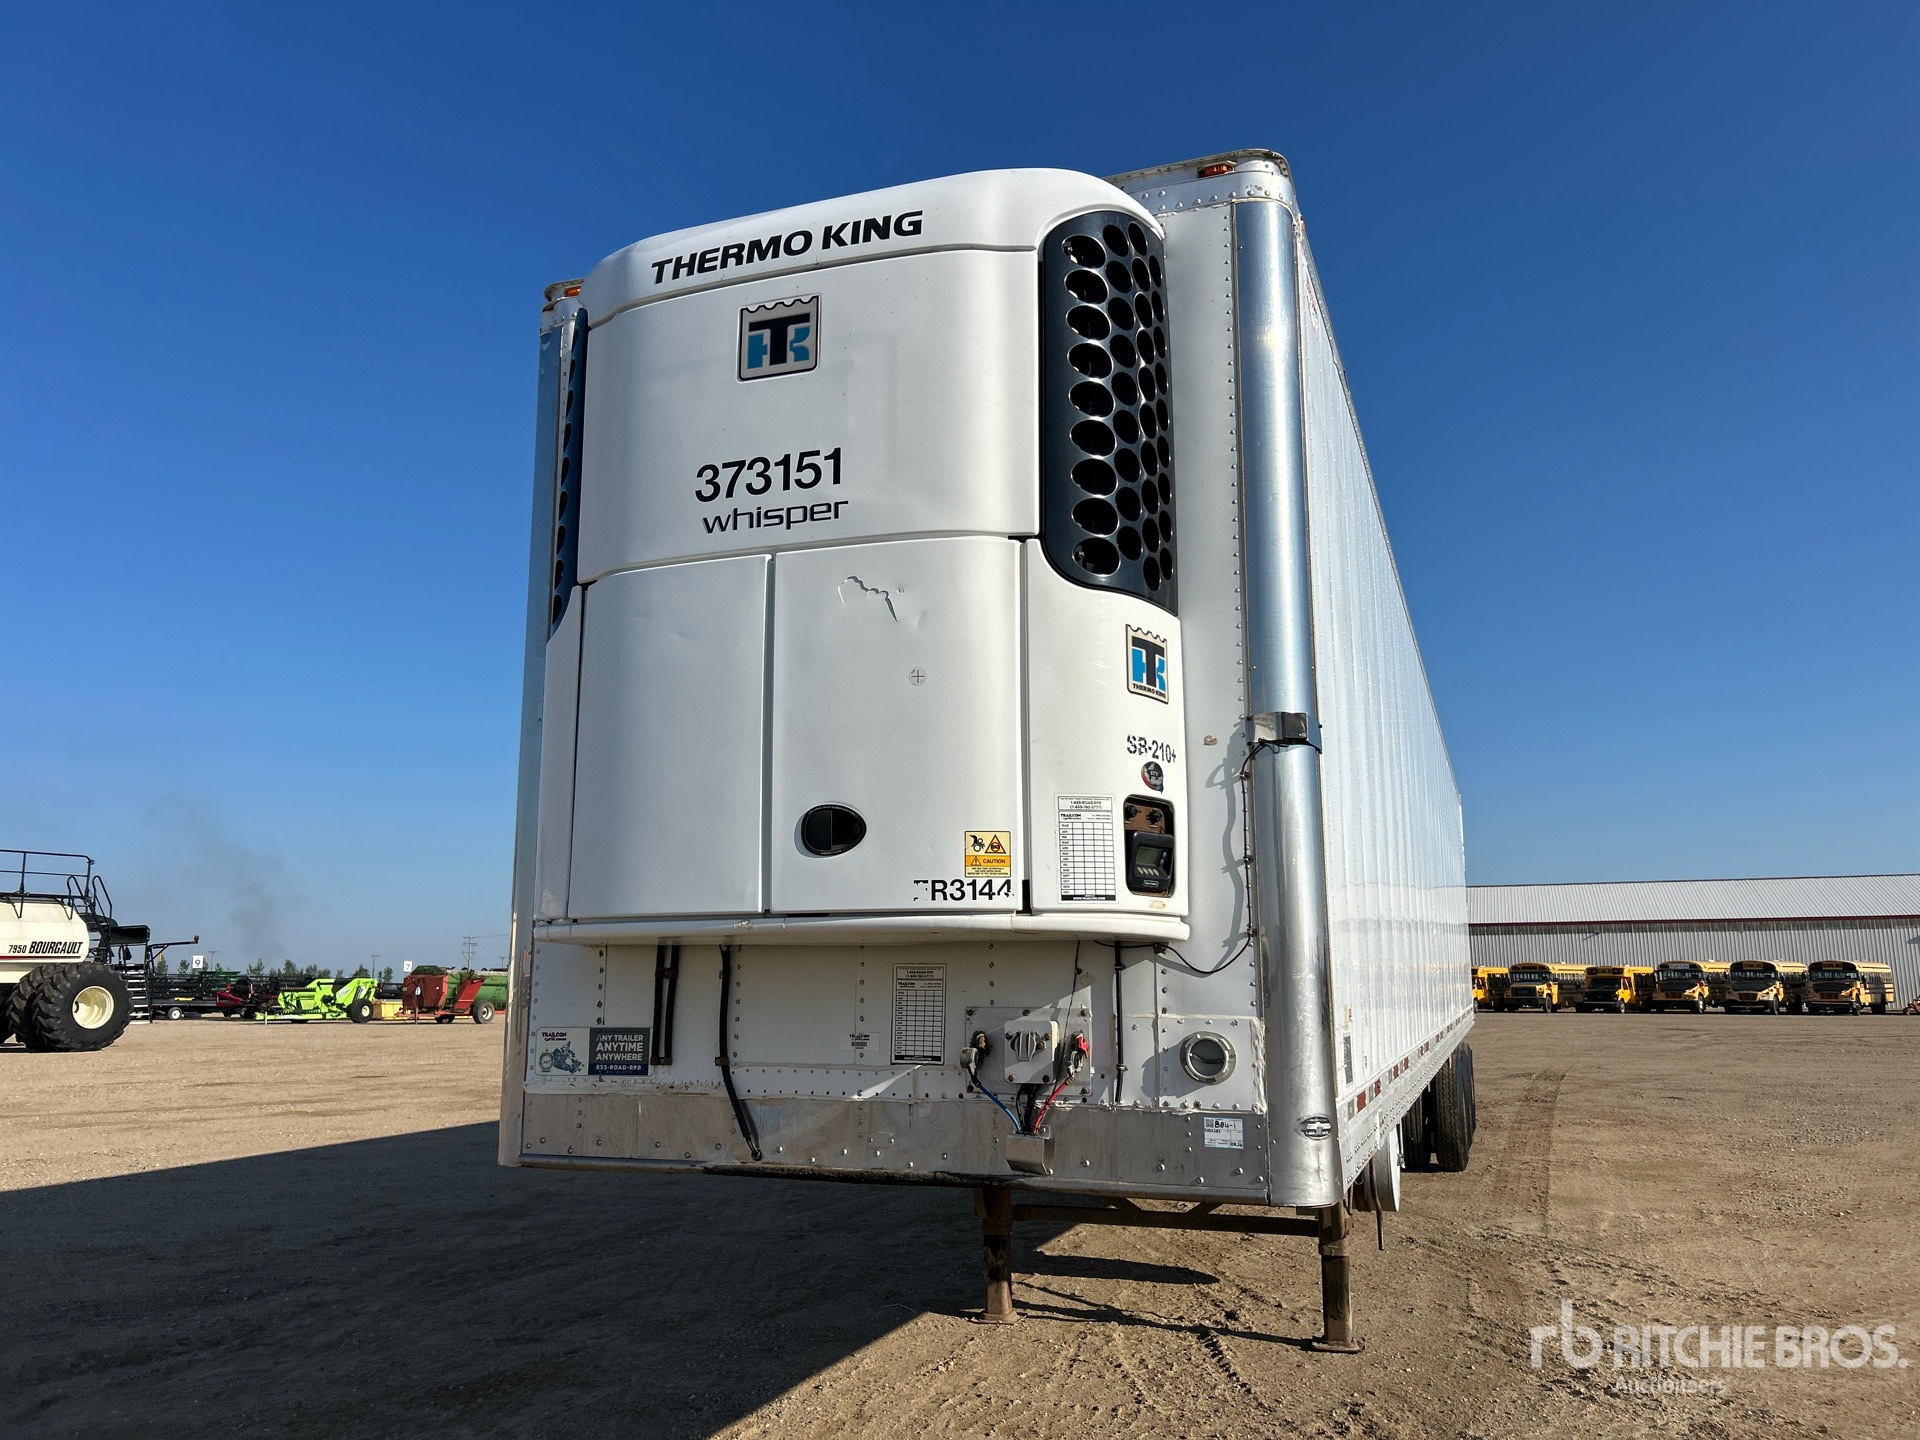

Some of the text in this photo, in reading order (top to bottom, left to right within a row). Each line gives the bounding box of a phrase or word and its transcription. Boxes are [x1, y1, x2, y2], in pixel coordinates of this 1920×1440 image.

[651, 210, 923, 285] THERMO KING
[695, 447, 841, 502] 373151
[702, 501, 849, 534] whisper
[1132, 683, 1166, 698] THERMO KING
[8, 941, 83, 954] 7950 BOURGAULT
[194, 959, 201, 967] 9
[404, 963, 411, 971] 7
[596, 1034, 644, 1042] ANY TRAILER
[596, 1042, 644, 1052] ANYTIME
[595, 1052, 643, 1061] ANYWHERE
